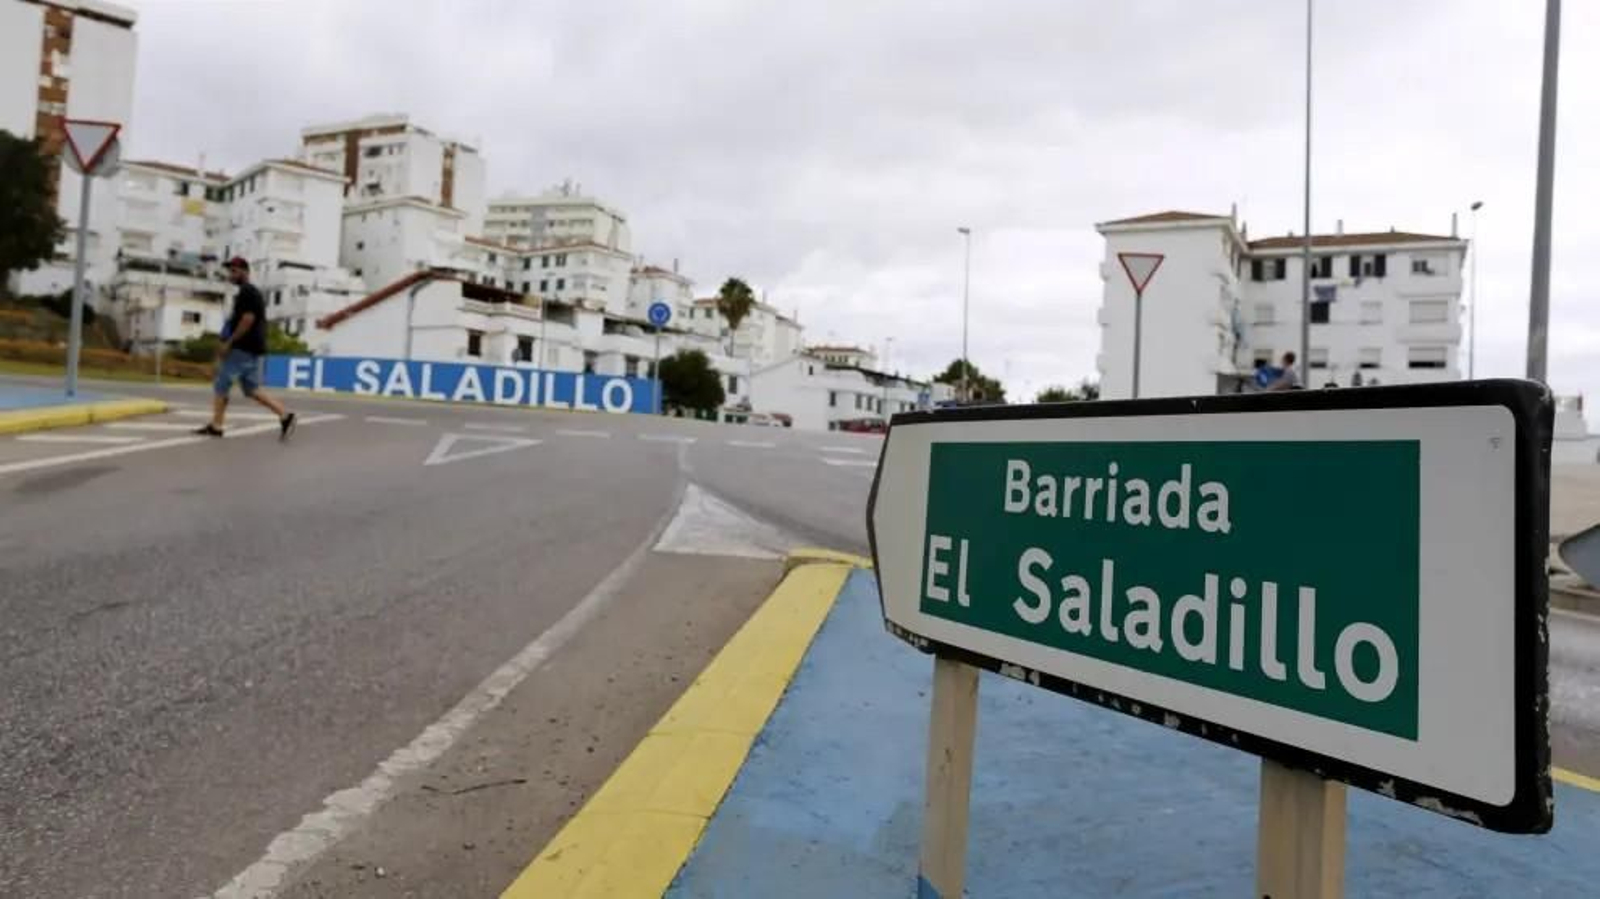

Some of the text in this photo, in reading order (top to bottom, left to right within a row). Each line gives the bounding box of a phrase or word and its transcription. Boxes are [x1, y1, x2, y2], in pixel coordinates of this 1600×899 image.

[287, 357, 634, 415] EL SALADILLO
[1003, 459, 1232, 535] Barriada
[925, 534, 1400, 703] El Saladillo
